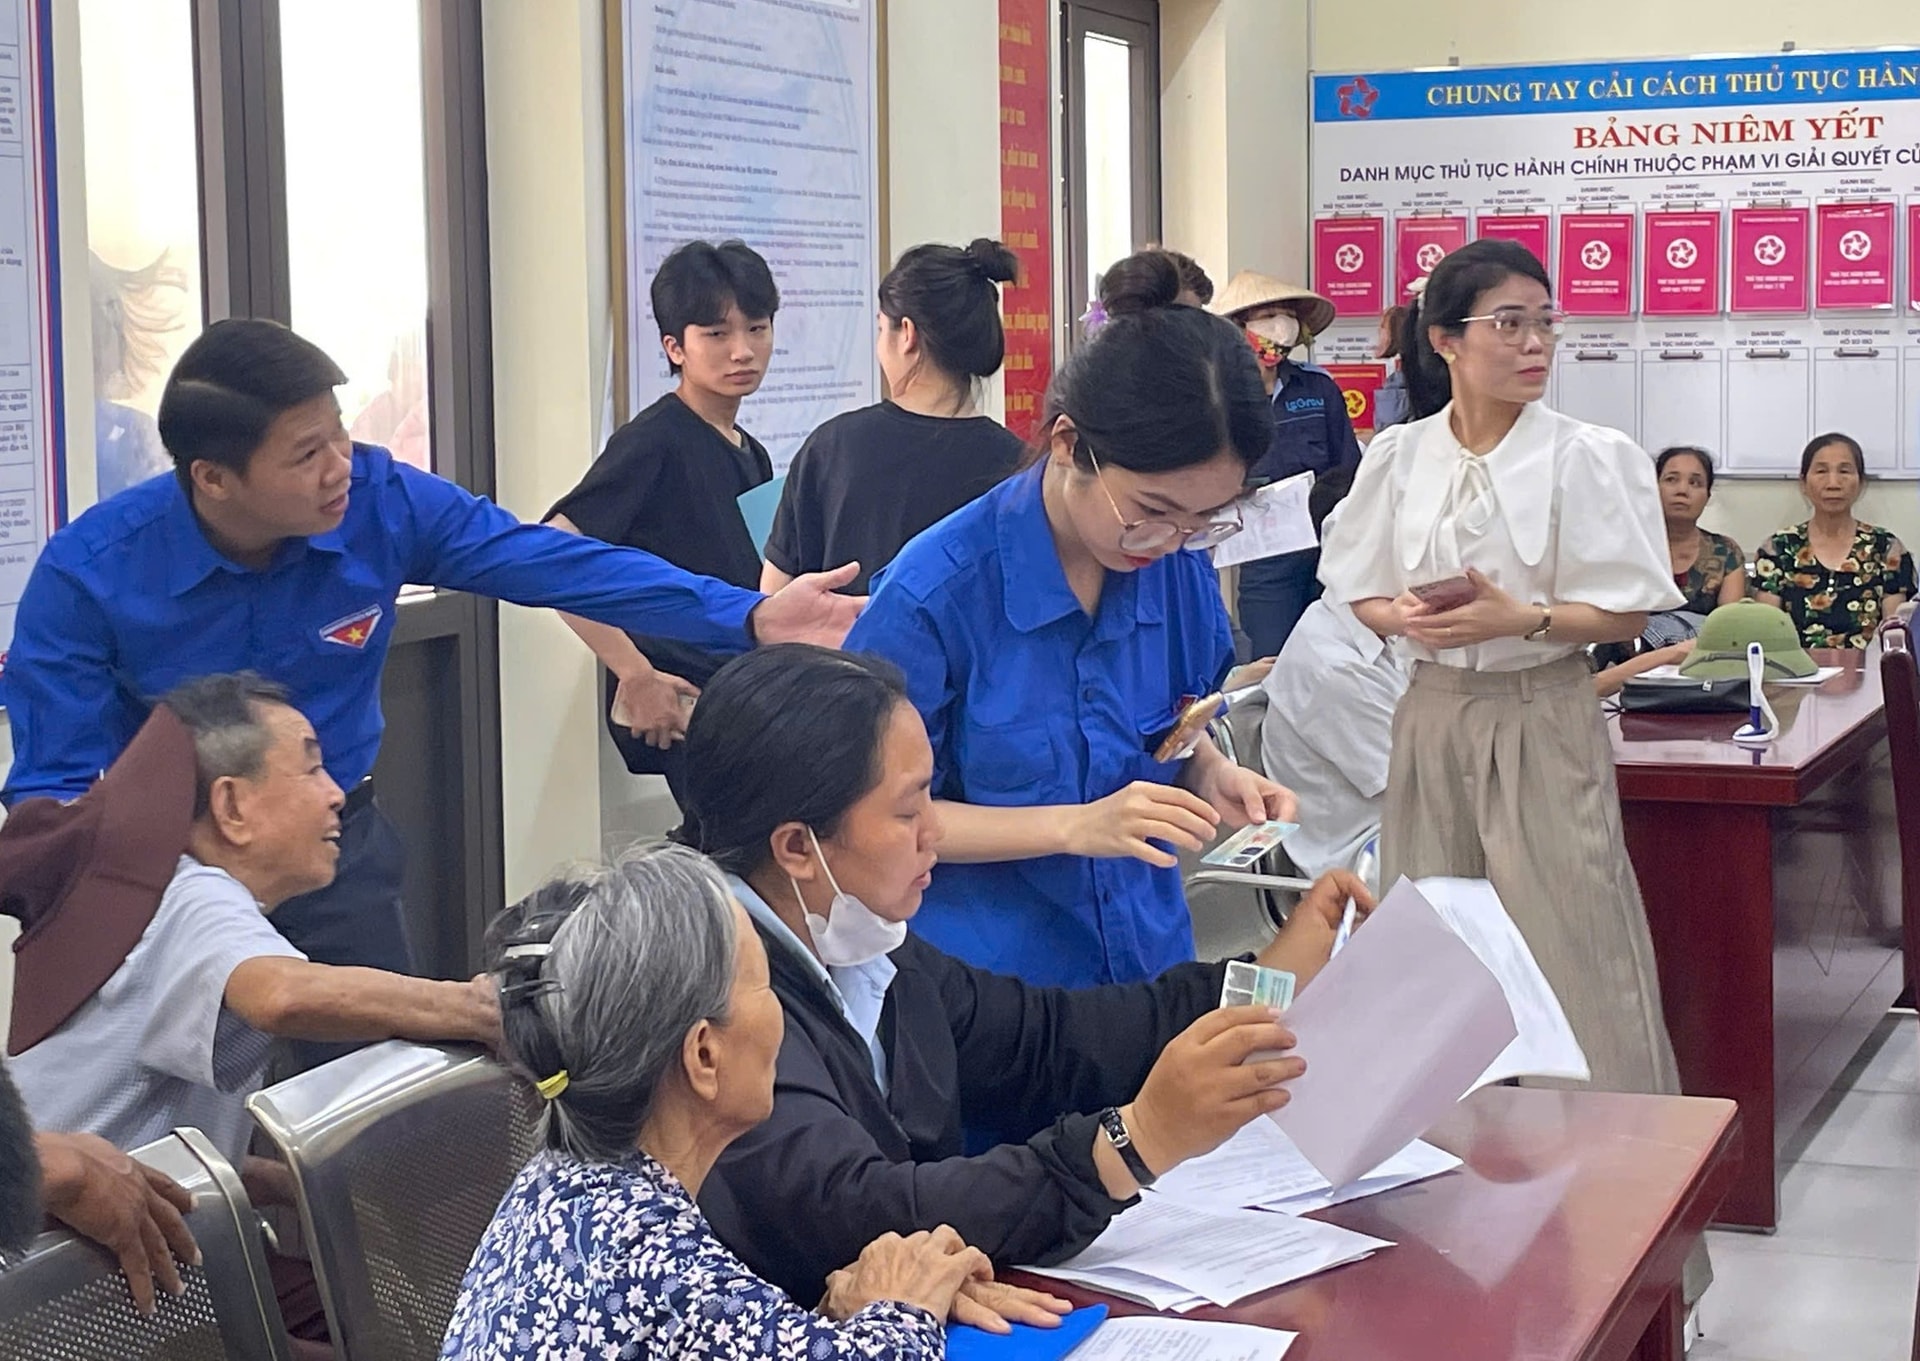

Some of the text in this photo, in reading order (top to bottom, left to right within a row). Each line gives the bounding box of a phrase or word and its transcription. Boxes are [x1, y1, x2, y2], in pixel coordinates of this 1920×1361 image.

[1427, 61, 1919, 106] CHUNG TAY CẢI CÁCH THỦ TỤC HÀN
[1573, 107, 1884, 149] BẢNG NIÊM YẾT
[1340, 167, 1389, 182] DANH
[1395, 164, 1436, 184] MỤC
[1440, 158, 1471, 179] THỦ
[1476, 162, 1510, 182] TỤC
[1514, 156, 1565, 177] HÀNH
[1571, 154, 1628, 175] CHÍNH
[1633, 153, 1697, 175] THUỘC
[1702, 153, 1756, 173] PHẠM
[1761, 152, 1779, 169] VI
[1785, 147, 1826, 168] GIẢI
[1831, 145, 1891, 167] QUYẾT
